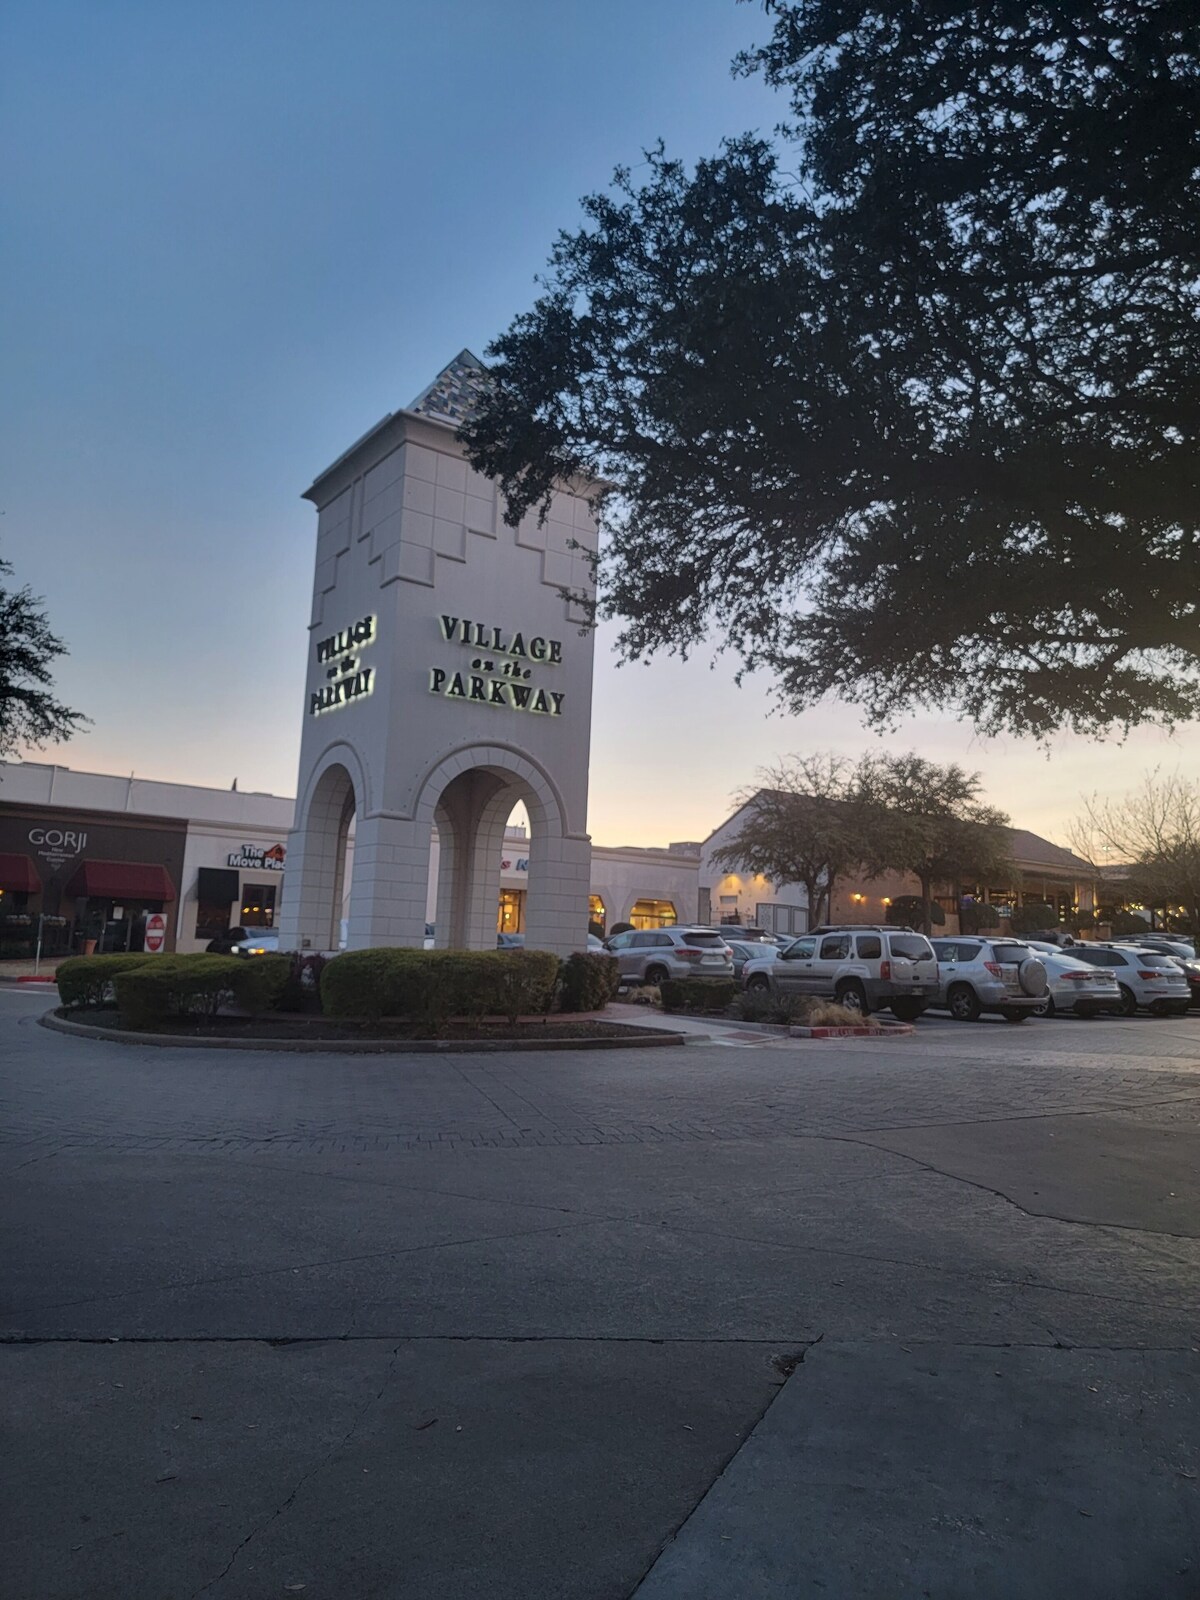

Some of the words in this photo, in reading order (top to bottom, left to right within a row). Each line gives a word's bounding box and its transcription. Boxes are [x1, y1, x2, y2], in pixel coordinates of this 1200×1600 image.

[316, 615, 374, 664] VILLAGE
[439, 614, 563, 664] VILLAGE
[471, 658, 494, 672] on
[502, 661, 532, 679] the
[309, 668, 374, 715] PARKWAY
[430, 667, 566, 716] PARKWAY
[28, 828, 87, 854] GORJI
[243, 844, 265, 858] The
[228, 854, 262, 868] Move
[264, 857, 286, 870] Plac
